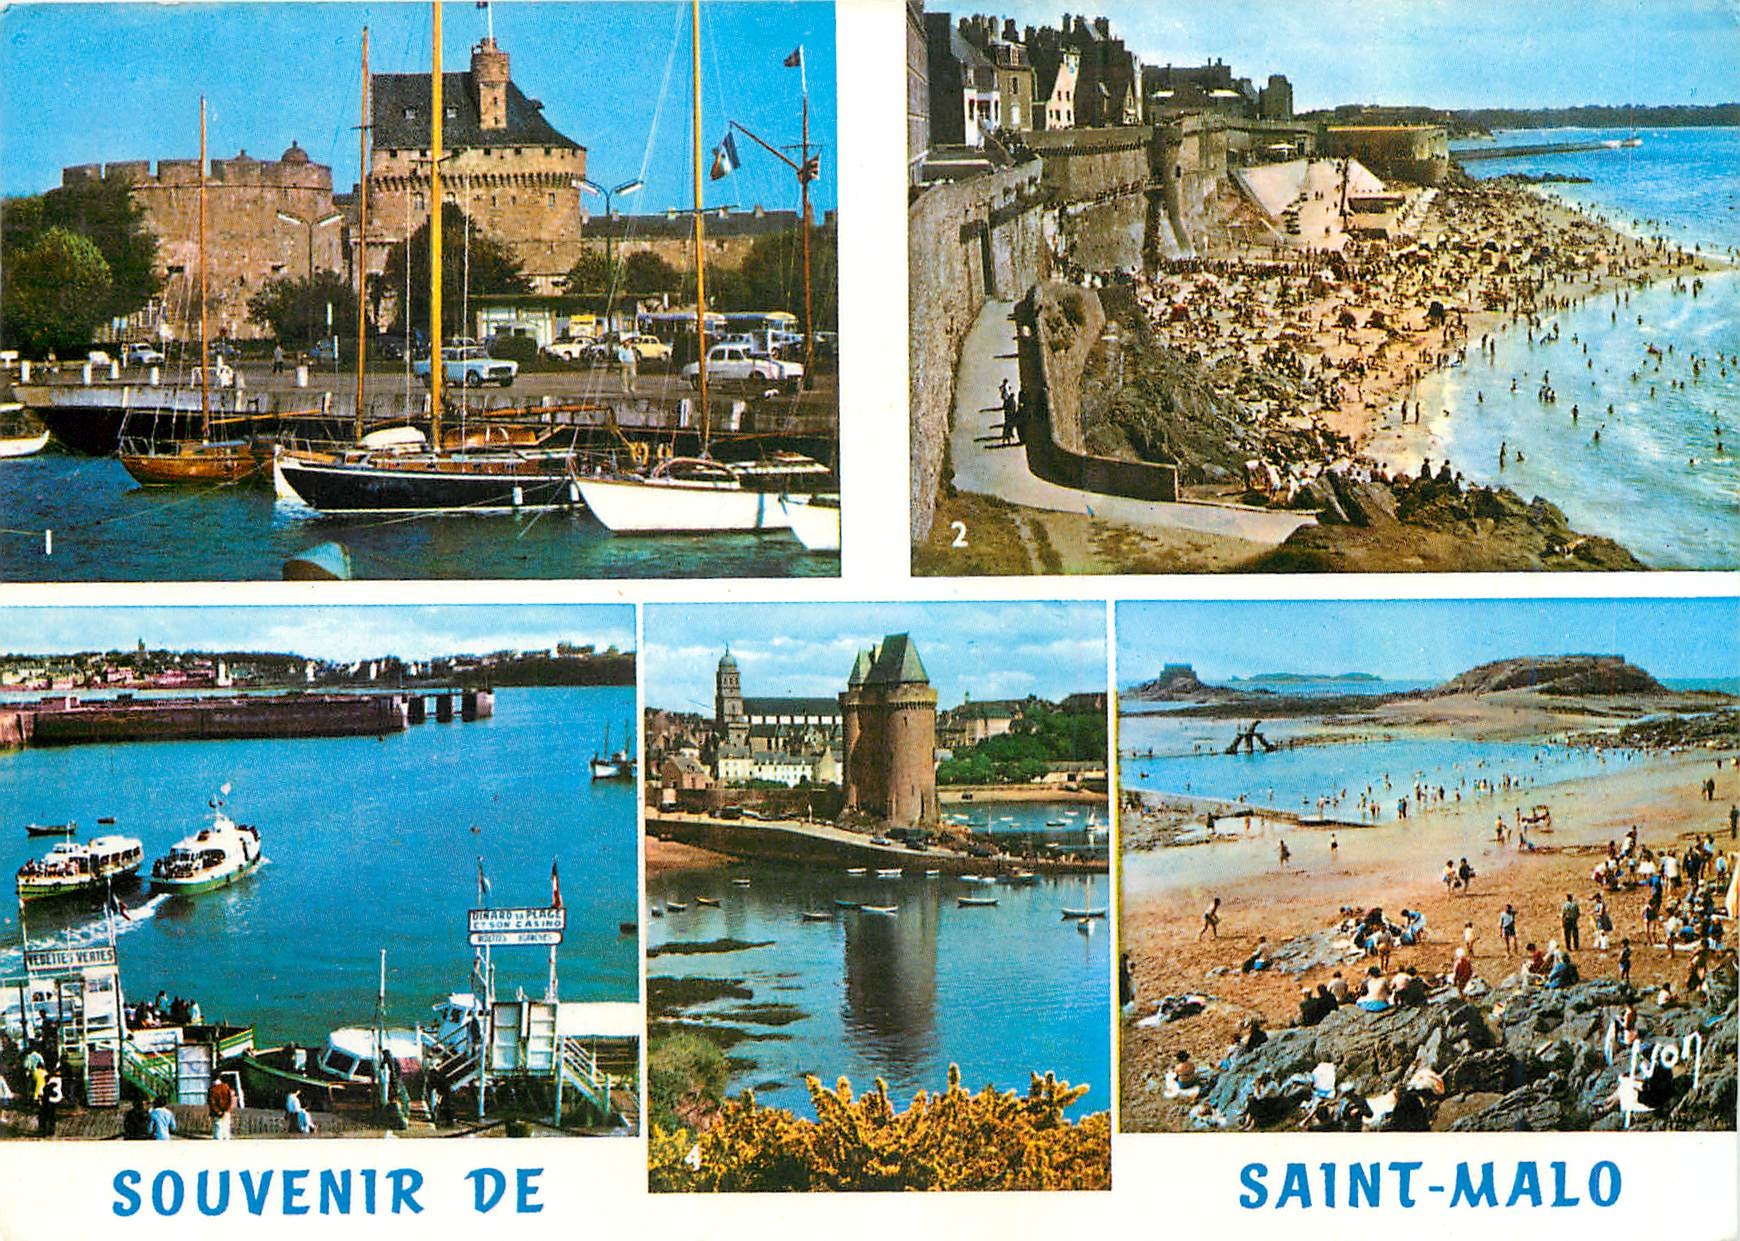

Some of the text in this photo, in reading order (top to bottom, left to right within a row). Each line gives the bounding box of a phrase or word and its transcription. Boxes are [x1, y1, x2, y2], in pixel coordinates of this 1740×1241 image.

[472, 911, 512, 920] DINARD
[526, 909, 562, 919] PLAGE
[489, 920, 510, 929] SON
[515, 919, 562, 928] CASINO
[75, 949, 114, 963] VERTES
